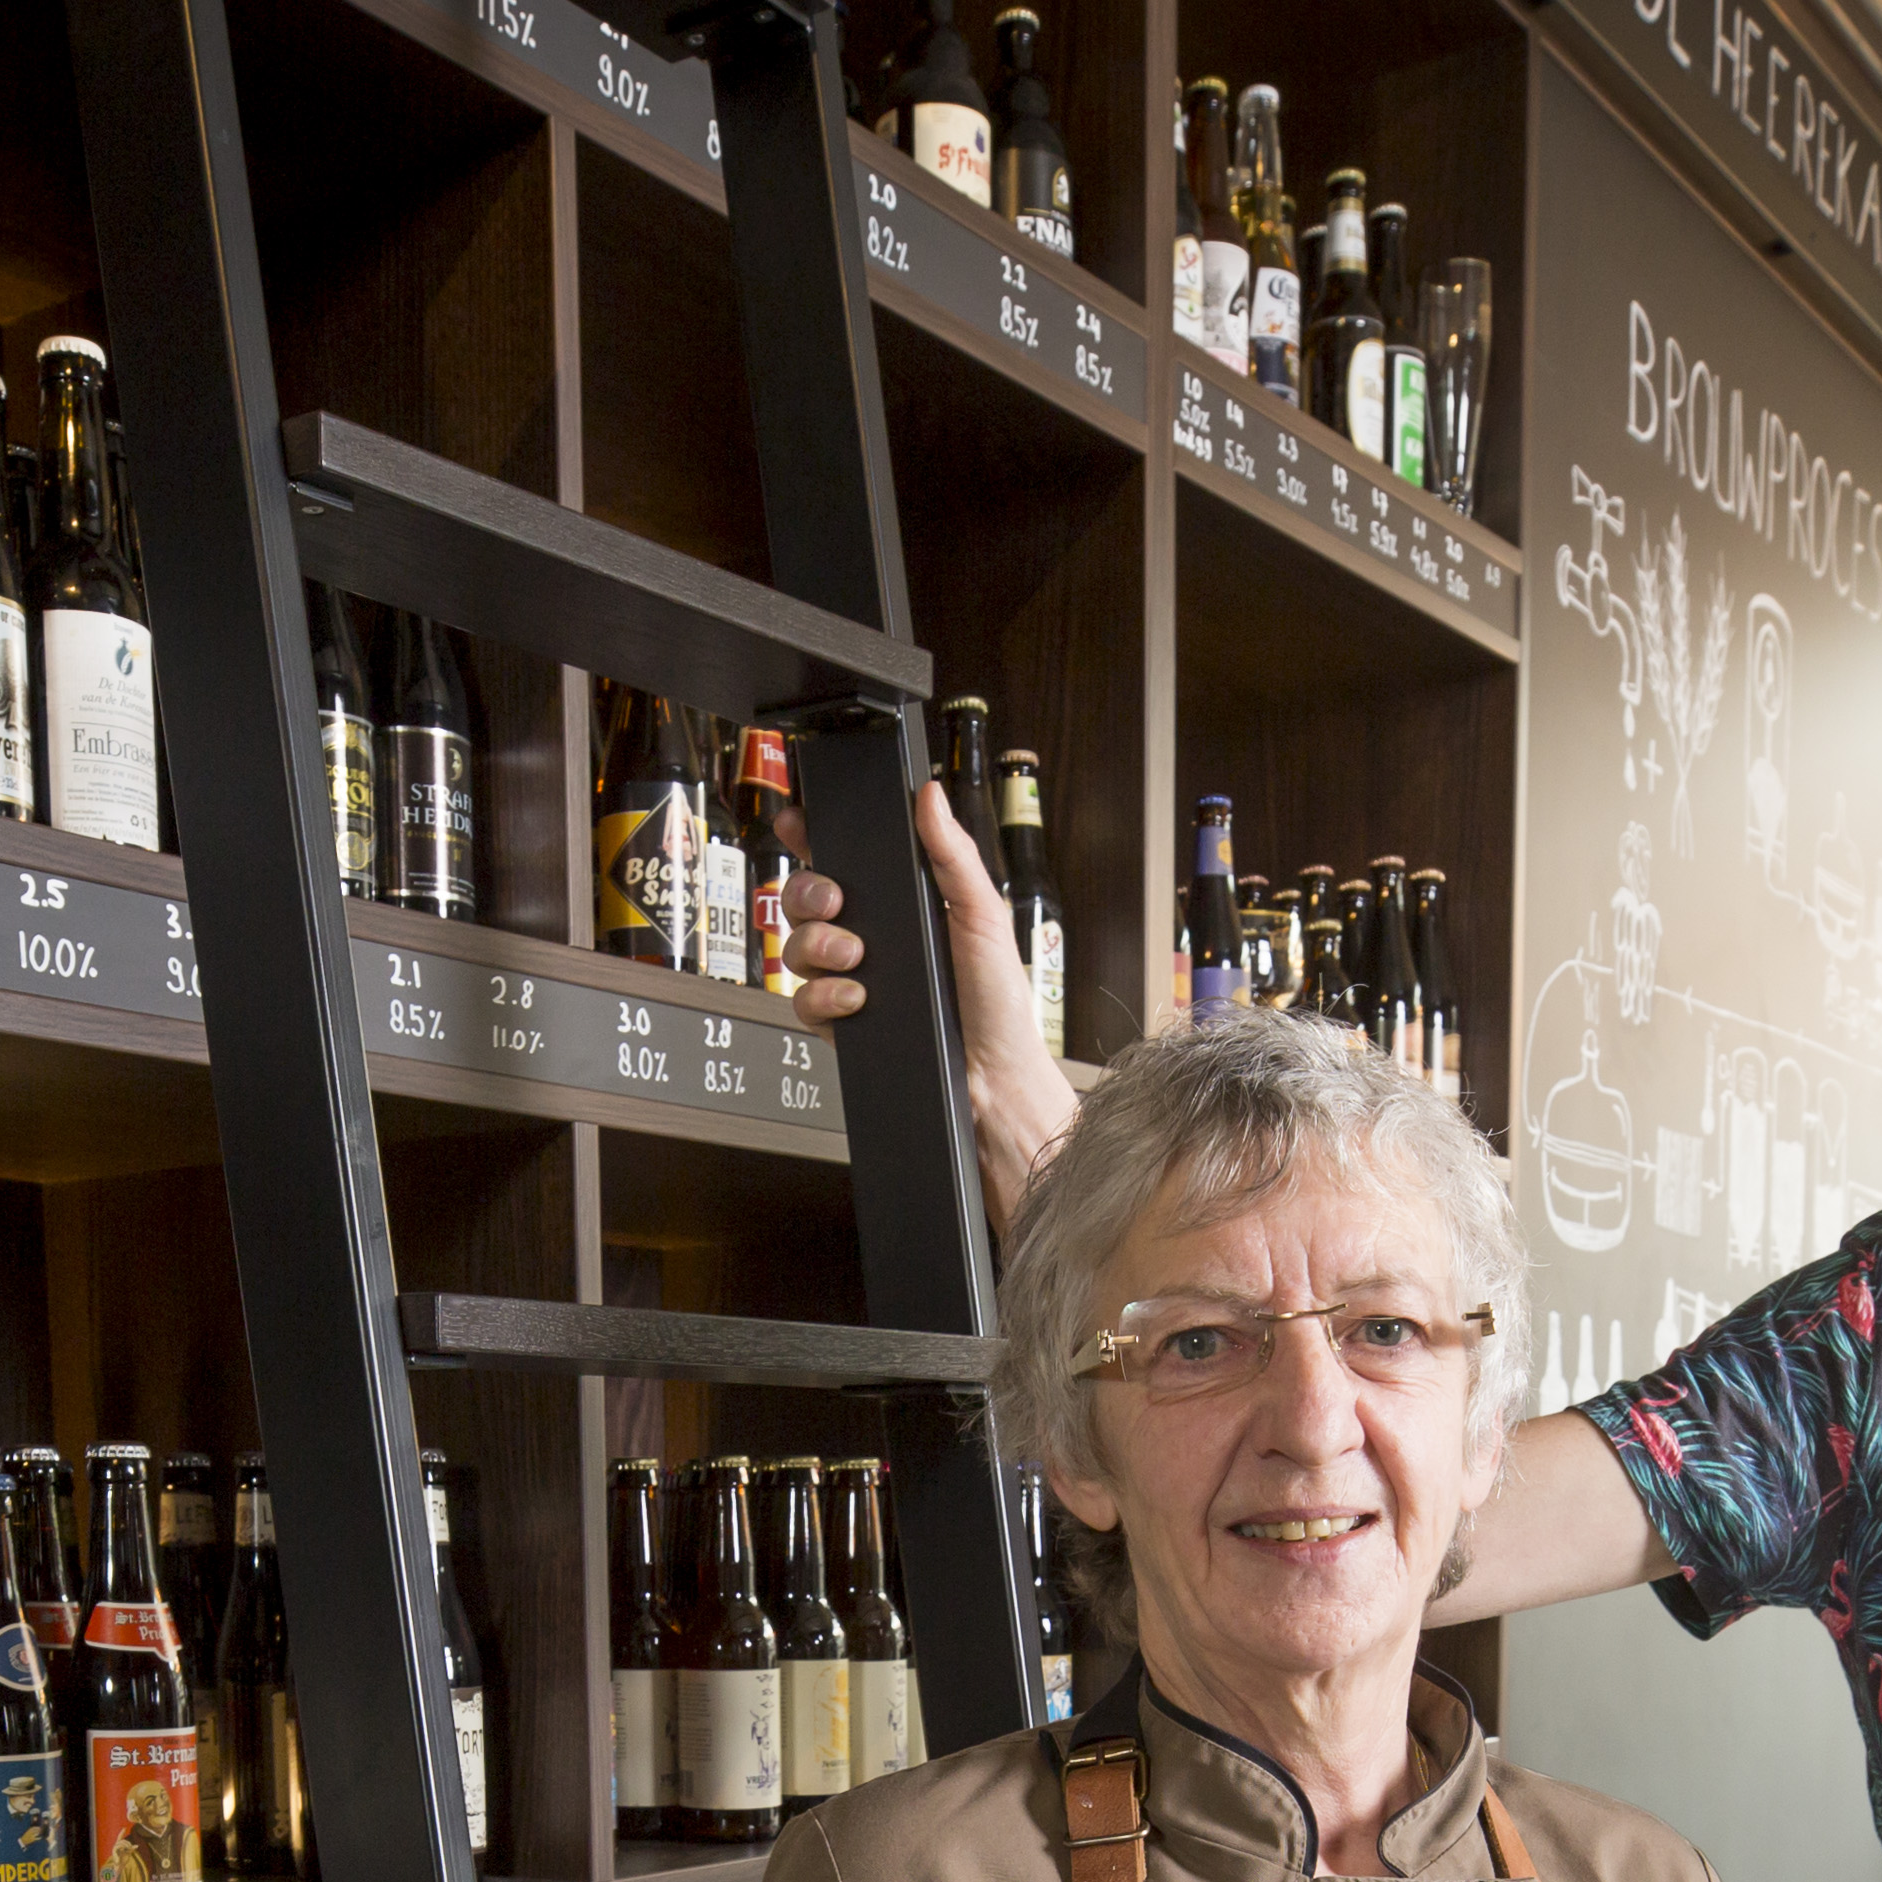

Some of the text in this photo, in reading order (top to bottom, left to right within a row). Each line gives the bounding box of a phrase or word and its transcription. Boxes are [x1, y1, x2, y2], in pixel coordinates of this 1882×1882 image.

[597, 54, 651, 116] 9.0%
[868, 173, 897, 211] 2.0
[999, 295, 1039, 347] 8.5%
[19, 873, 69, 910] 2.5
[18, 930, 98, 979] 10.0%
[387, 953, 421, 989] 2.1
[491, 975, 535, 1010] 2.8
[389, 998, 445, 1040] 8.5%
[617, 1001, 651, 1036] 3.0
[703, 1017, 733, 1049] 2.8
[618, 1042, 669, 1082] 8.0%
[704, 1060, 746, 1095] 8.5%
